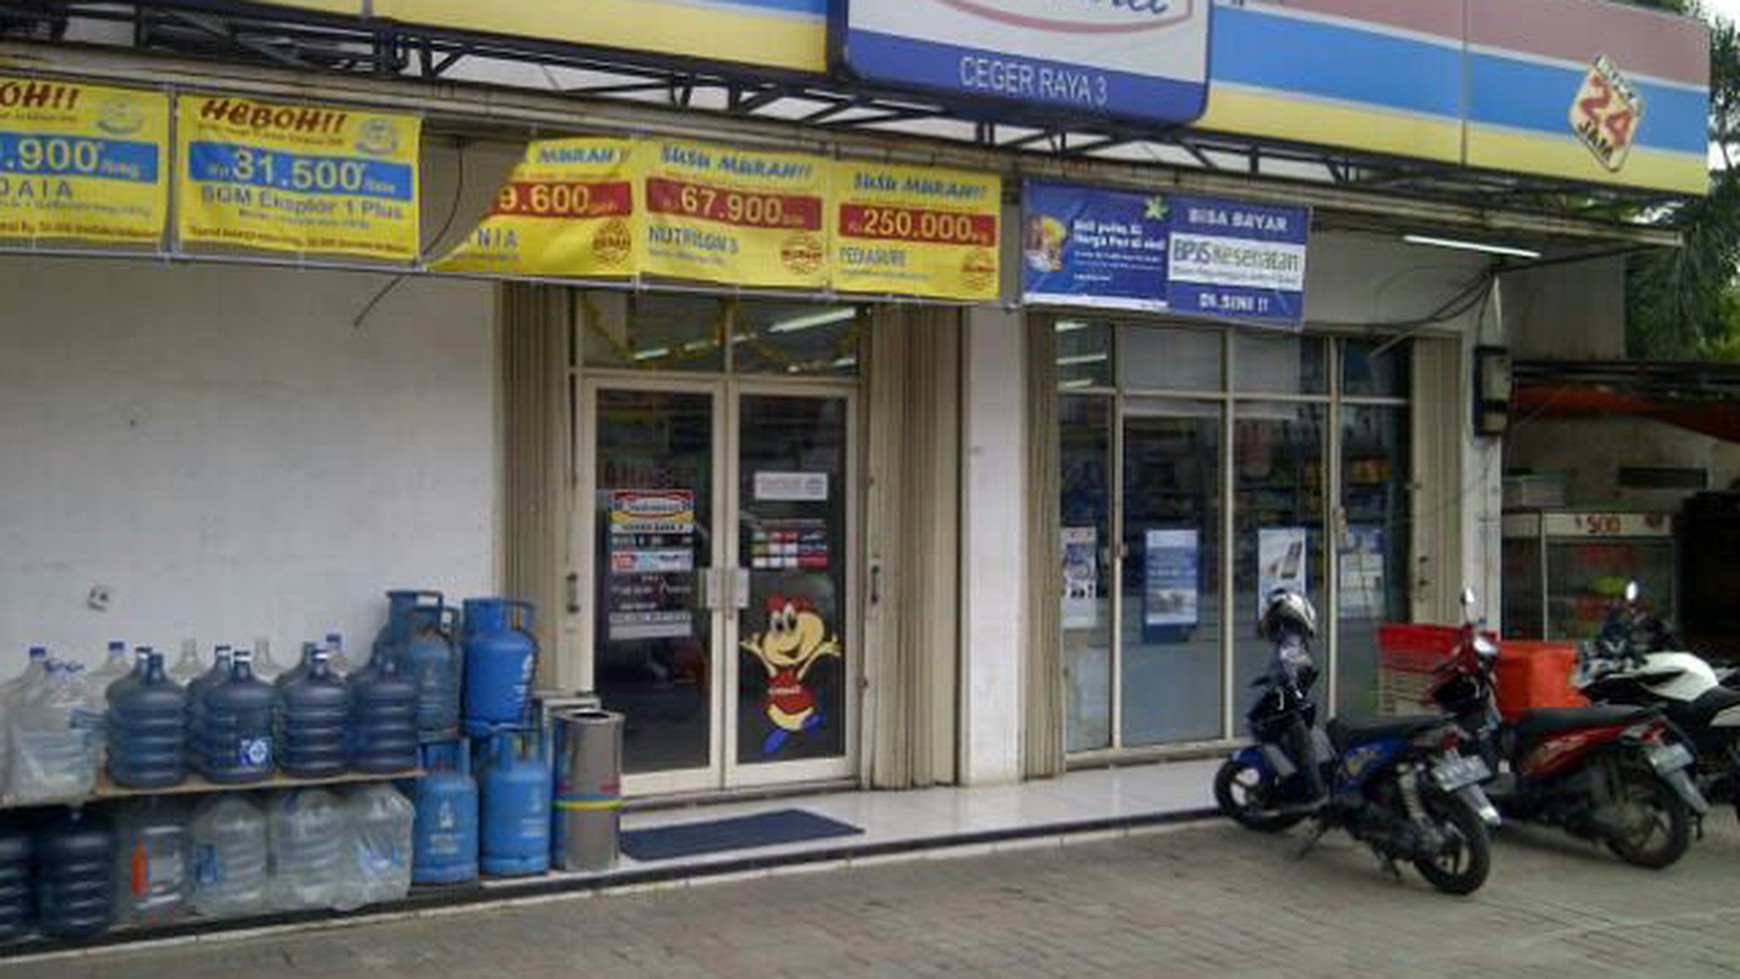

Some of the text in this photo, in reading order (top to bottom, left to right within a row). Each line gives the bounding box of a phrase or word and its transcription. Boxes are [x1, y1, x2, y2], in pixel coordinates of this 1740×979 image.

[959, 55, 1108, 107] CEGER RAYA 3
[680, 185, 784, 225] 67.900
[1189, 207, 1288, 233] BISA BAYAR
[863, 207, 974, 242] 250.000
[1219, 294, 1256, 312] SINI
